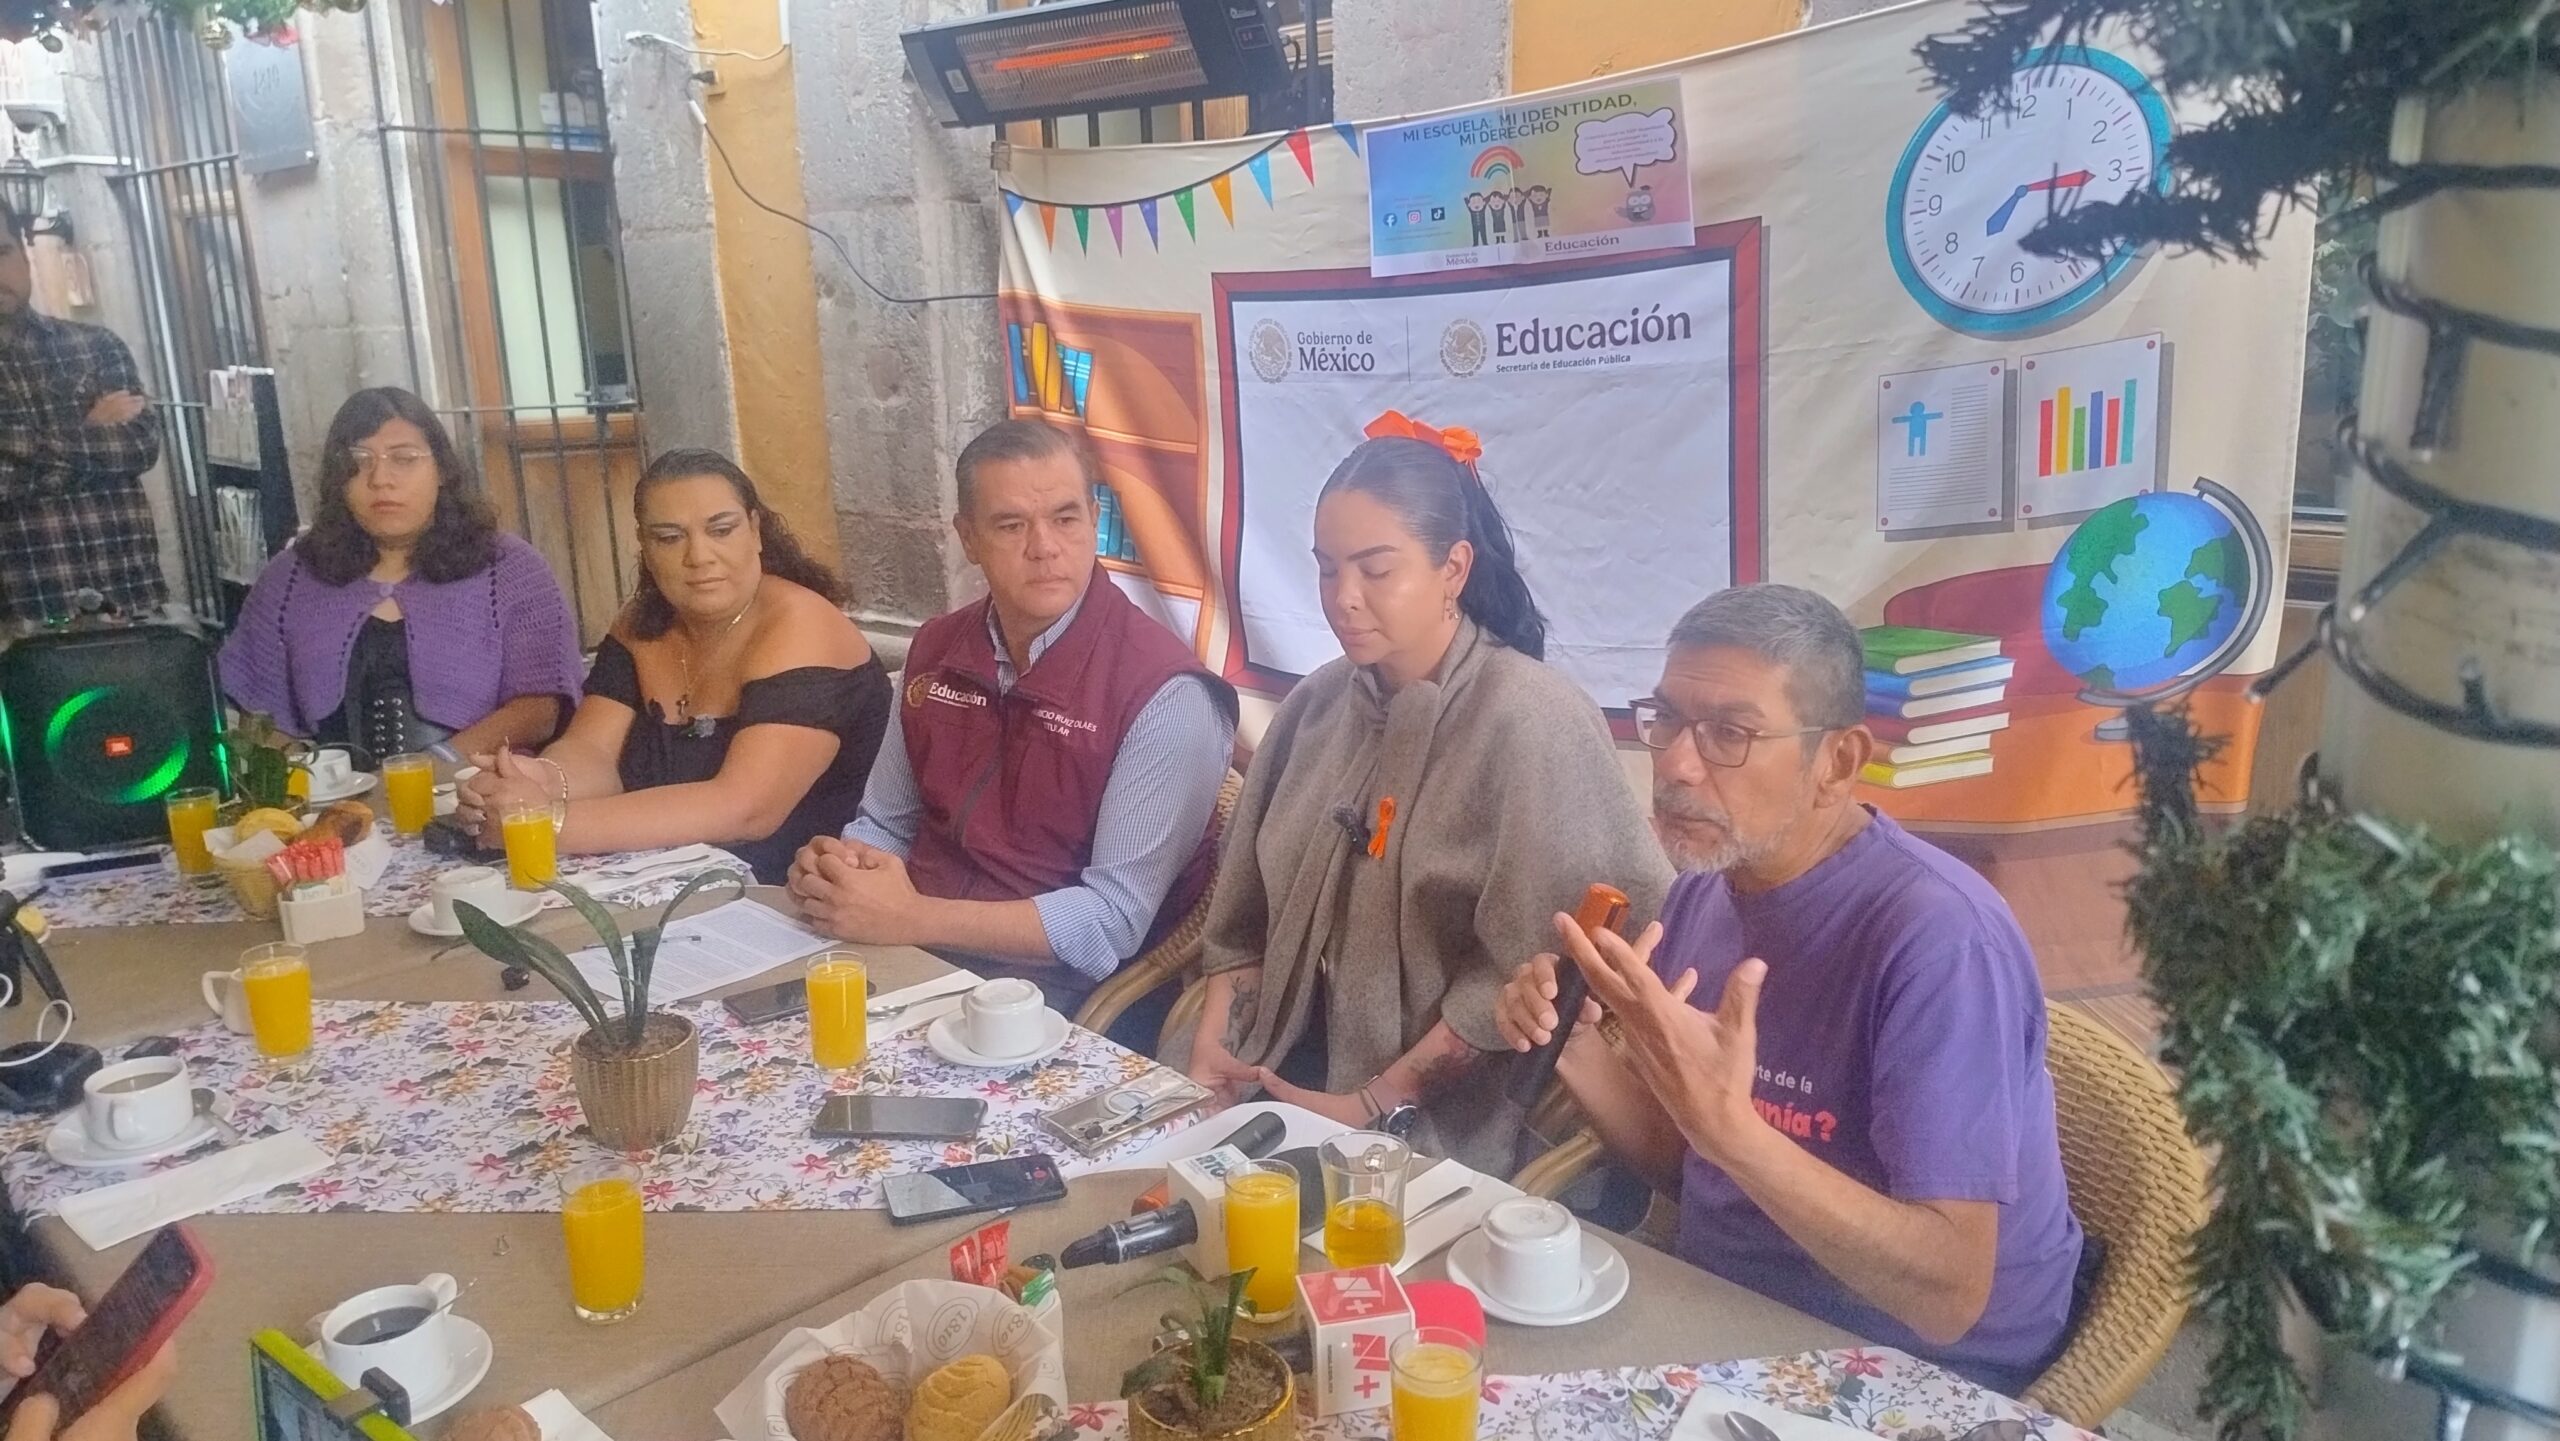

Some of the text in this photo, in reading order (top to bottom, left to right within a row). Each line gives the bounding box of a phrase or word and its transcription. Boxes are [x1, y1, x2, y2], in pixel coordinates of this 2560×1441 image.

[1402, 94, 1637, 143] MI ESCUELA: MI IDENTIDAD,
[2014, 95, 2037, 119] 12
[2066, 98, 2073, 120] 1
[1459, 120, 1560, 147] MI DERECHO
[1979, 115, 1992, 140] 11
[2091, 120, 2108, 144] 2
[1945, 150, 1966, 174] 10
[2107, 159, 2122, 182] 3
[1928, 194, 1943, 216] 9
[1544, 234, 1620, 252] Educación
[1945, 232, 1959, 254] 8
[1445, 254, 1479, 267] México
[1972, 256, 1985, 278] 7
[2010, 261, 2024, 283] 6
[1297, 330, 1373, 345] Gobierno de
[1495, 303, 1692, 357] Educación
[1298, 346, 1375, 372] México
[1496, 354, 1631, 373] Secretaría de Educación Pública
[1054, 714, 1074, 728] RUIZ
[1775, 1070, 1796, 1089] de
[1800, 1075, 1813, 1095] la
[937, 1310, 968, 1348] 1810
